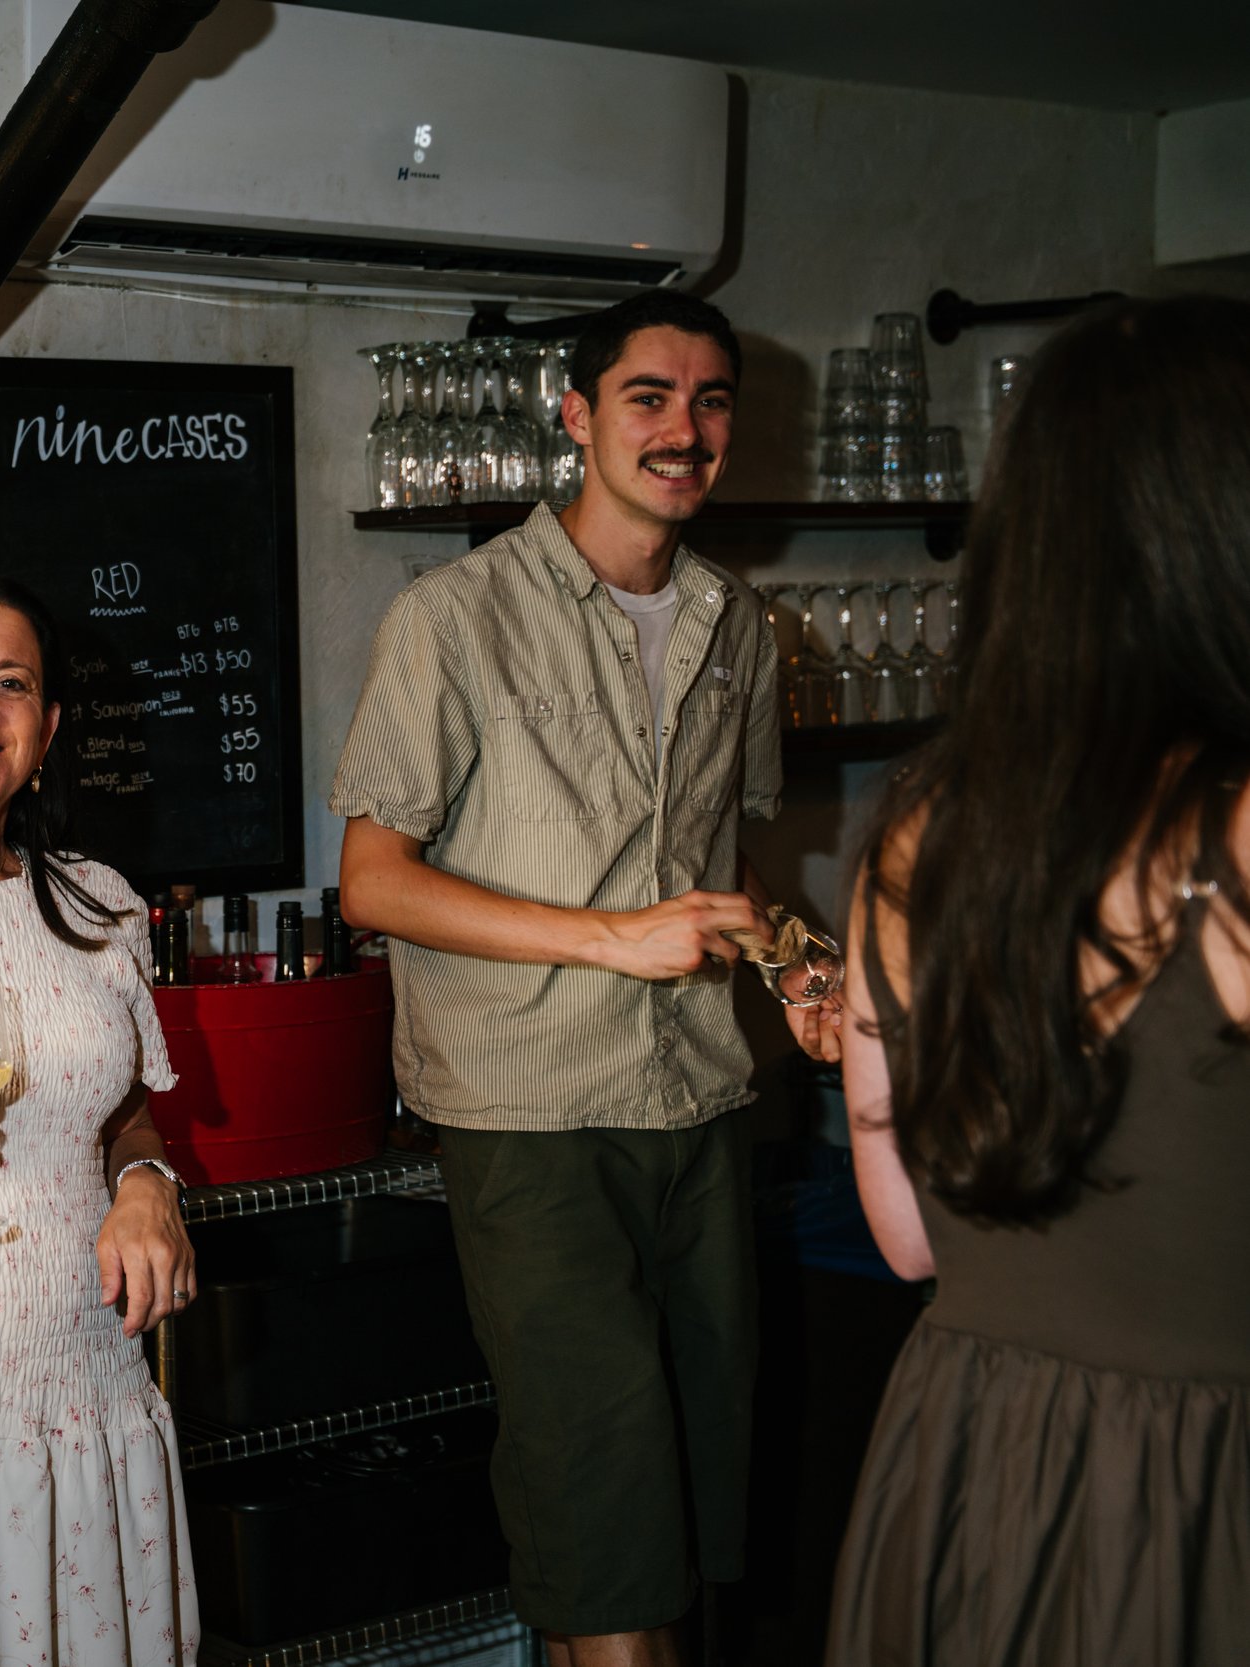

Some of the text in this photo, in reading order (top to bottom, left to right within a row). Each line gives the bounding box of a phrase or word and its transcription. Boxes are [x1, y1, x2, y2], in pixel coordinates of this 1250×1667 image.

[11, 404, 248, 469] nine CASES
[91, 561, 141, 602] RED
[213, 616, 239, 633] BTB
[180, 652, 208, 678] $13
[215, 648, 252, 675] $50
[91, 699, 162, 721] Sauvignon
[219, 692, 257, 717] $55
[87, 733, 125, 752] Blend
[220, 726, 261, 754] $55
[223, 762, 257, 783] $70
